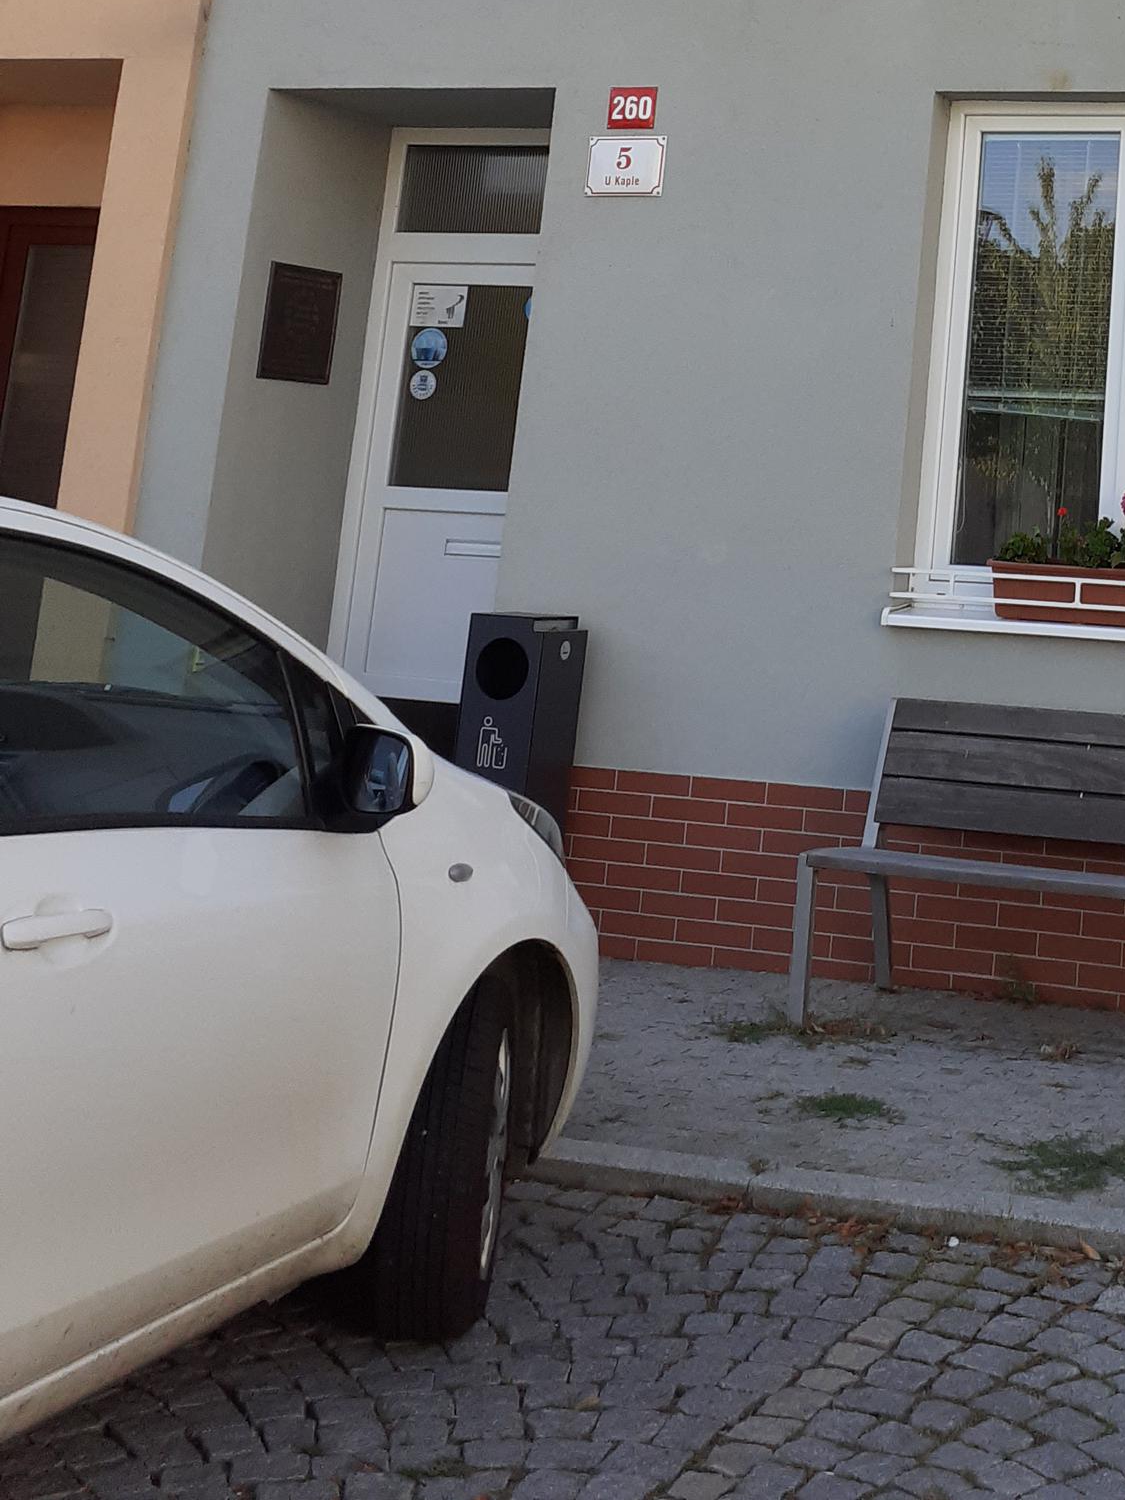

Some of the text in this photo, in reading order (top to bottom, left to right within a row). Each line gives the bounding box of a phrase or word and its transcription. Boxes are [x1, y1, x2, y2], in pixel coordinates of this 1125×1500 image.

[611, 96, 653, 120] 260
[616, 147, 632, 170] 5
[605, 176, 640, 187] U Kaple
